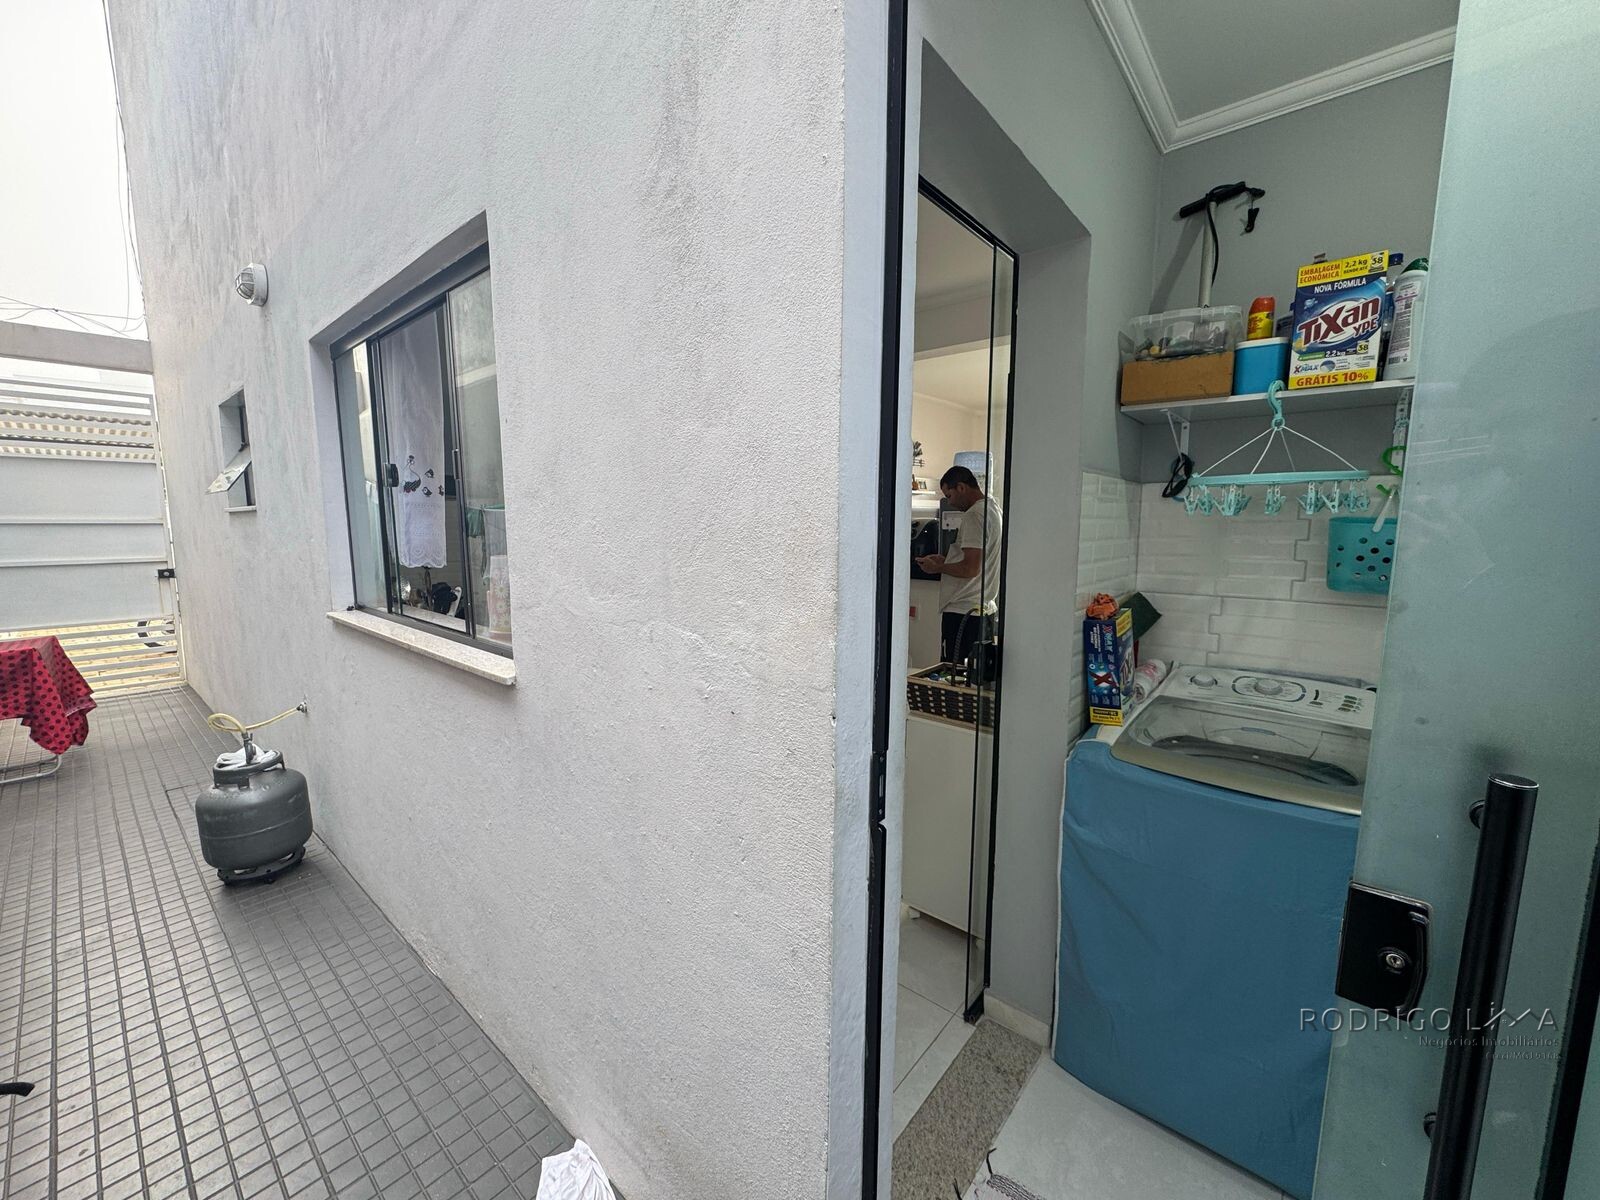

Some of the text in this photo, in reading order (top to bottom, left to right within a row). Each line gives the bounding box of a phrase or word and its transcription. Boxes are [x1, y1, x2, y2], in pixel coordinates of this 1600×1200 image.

[1358, 258, 1368, 267] kg
[1300, 263, 1341, 277] EMBALAGEM
[1299, 271, 1340, 284] ECONÔMICA
[1314, 277, 1367, 294] NOVA FÓRMULA
[1296, 371, 1369, 387] GRÁTIS 10%
